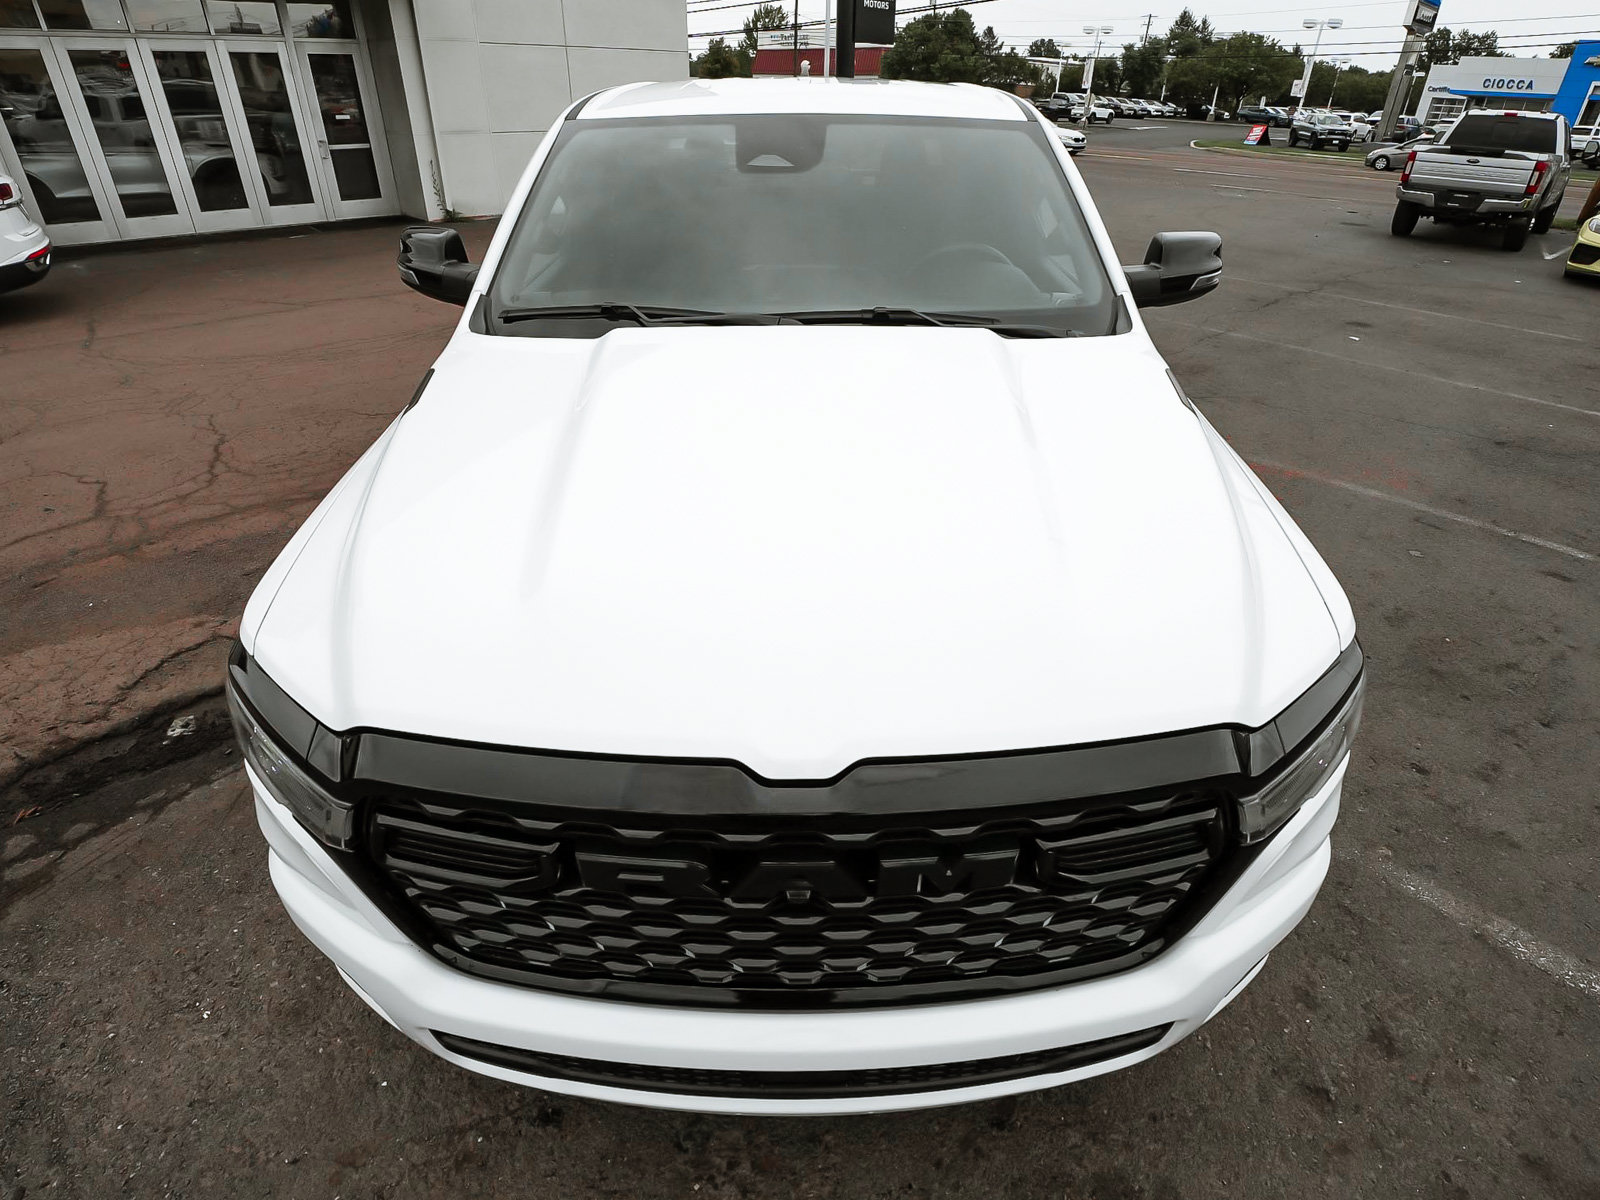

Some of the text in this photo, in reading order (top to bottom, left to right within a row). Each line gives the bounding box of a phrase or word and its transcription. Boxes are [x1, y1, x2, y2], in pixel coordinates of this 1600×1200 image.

[863, 0, 890, 10] MOTORS
[1482, 78, 1534, 91] CIOCCA
[575, 849, 1021, 899] RAM
